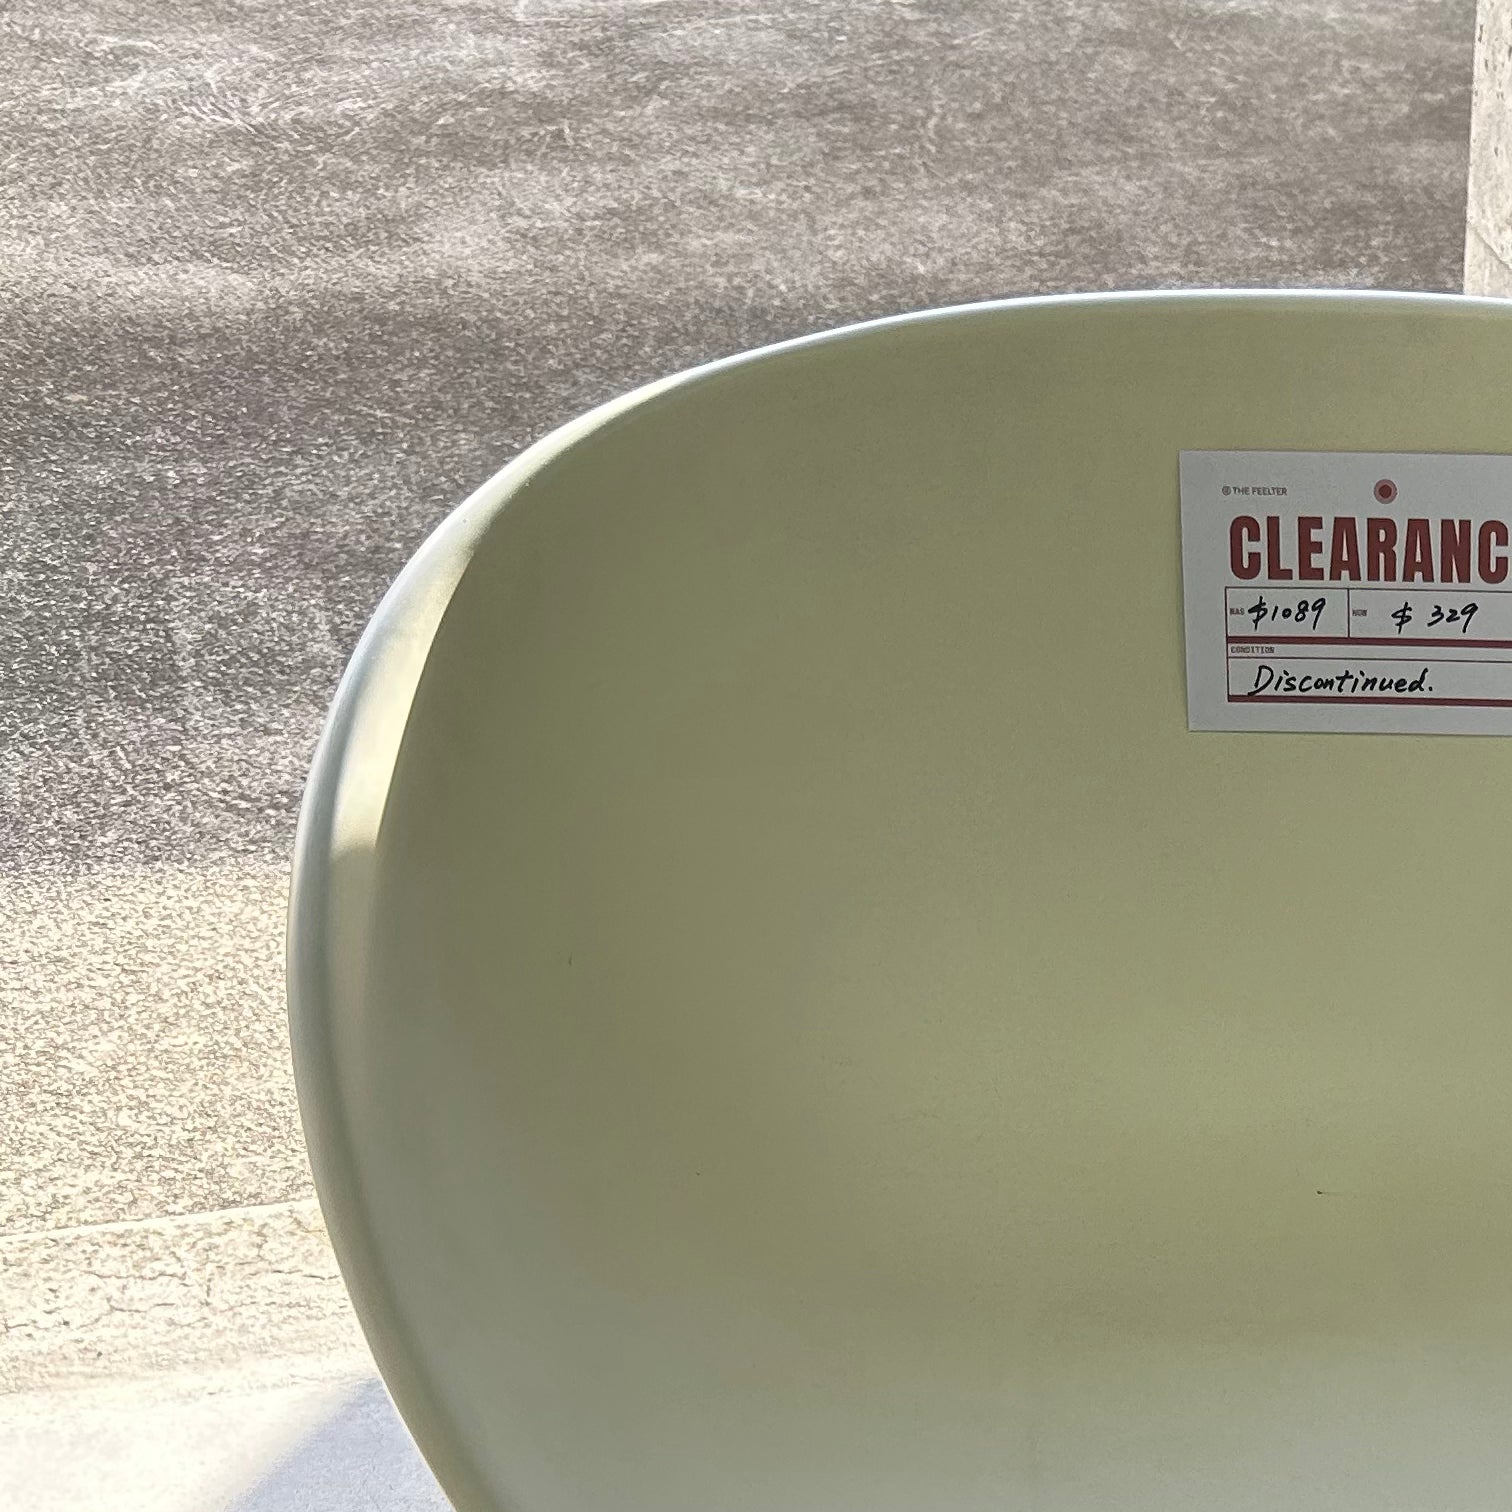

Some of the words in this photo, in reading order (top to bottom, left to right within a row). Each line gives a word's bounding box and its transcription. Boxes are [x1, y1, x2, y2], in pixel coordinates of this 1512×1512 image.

[1231, 486, 1250, 496] THE
[1251, 486, 1288, 496] FEELTER
[1247, 595, 1327, 631] $1089
[1230, 645, 1275, 654] CONDITION
[1247, 665, 1434, 697] Discontinued.
